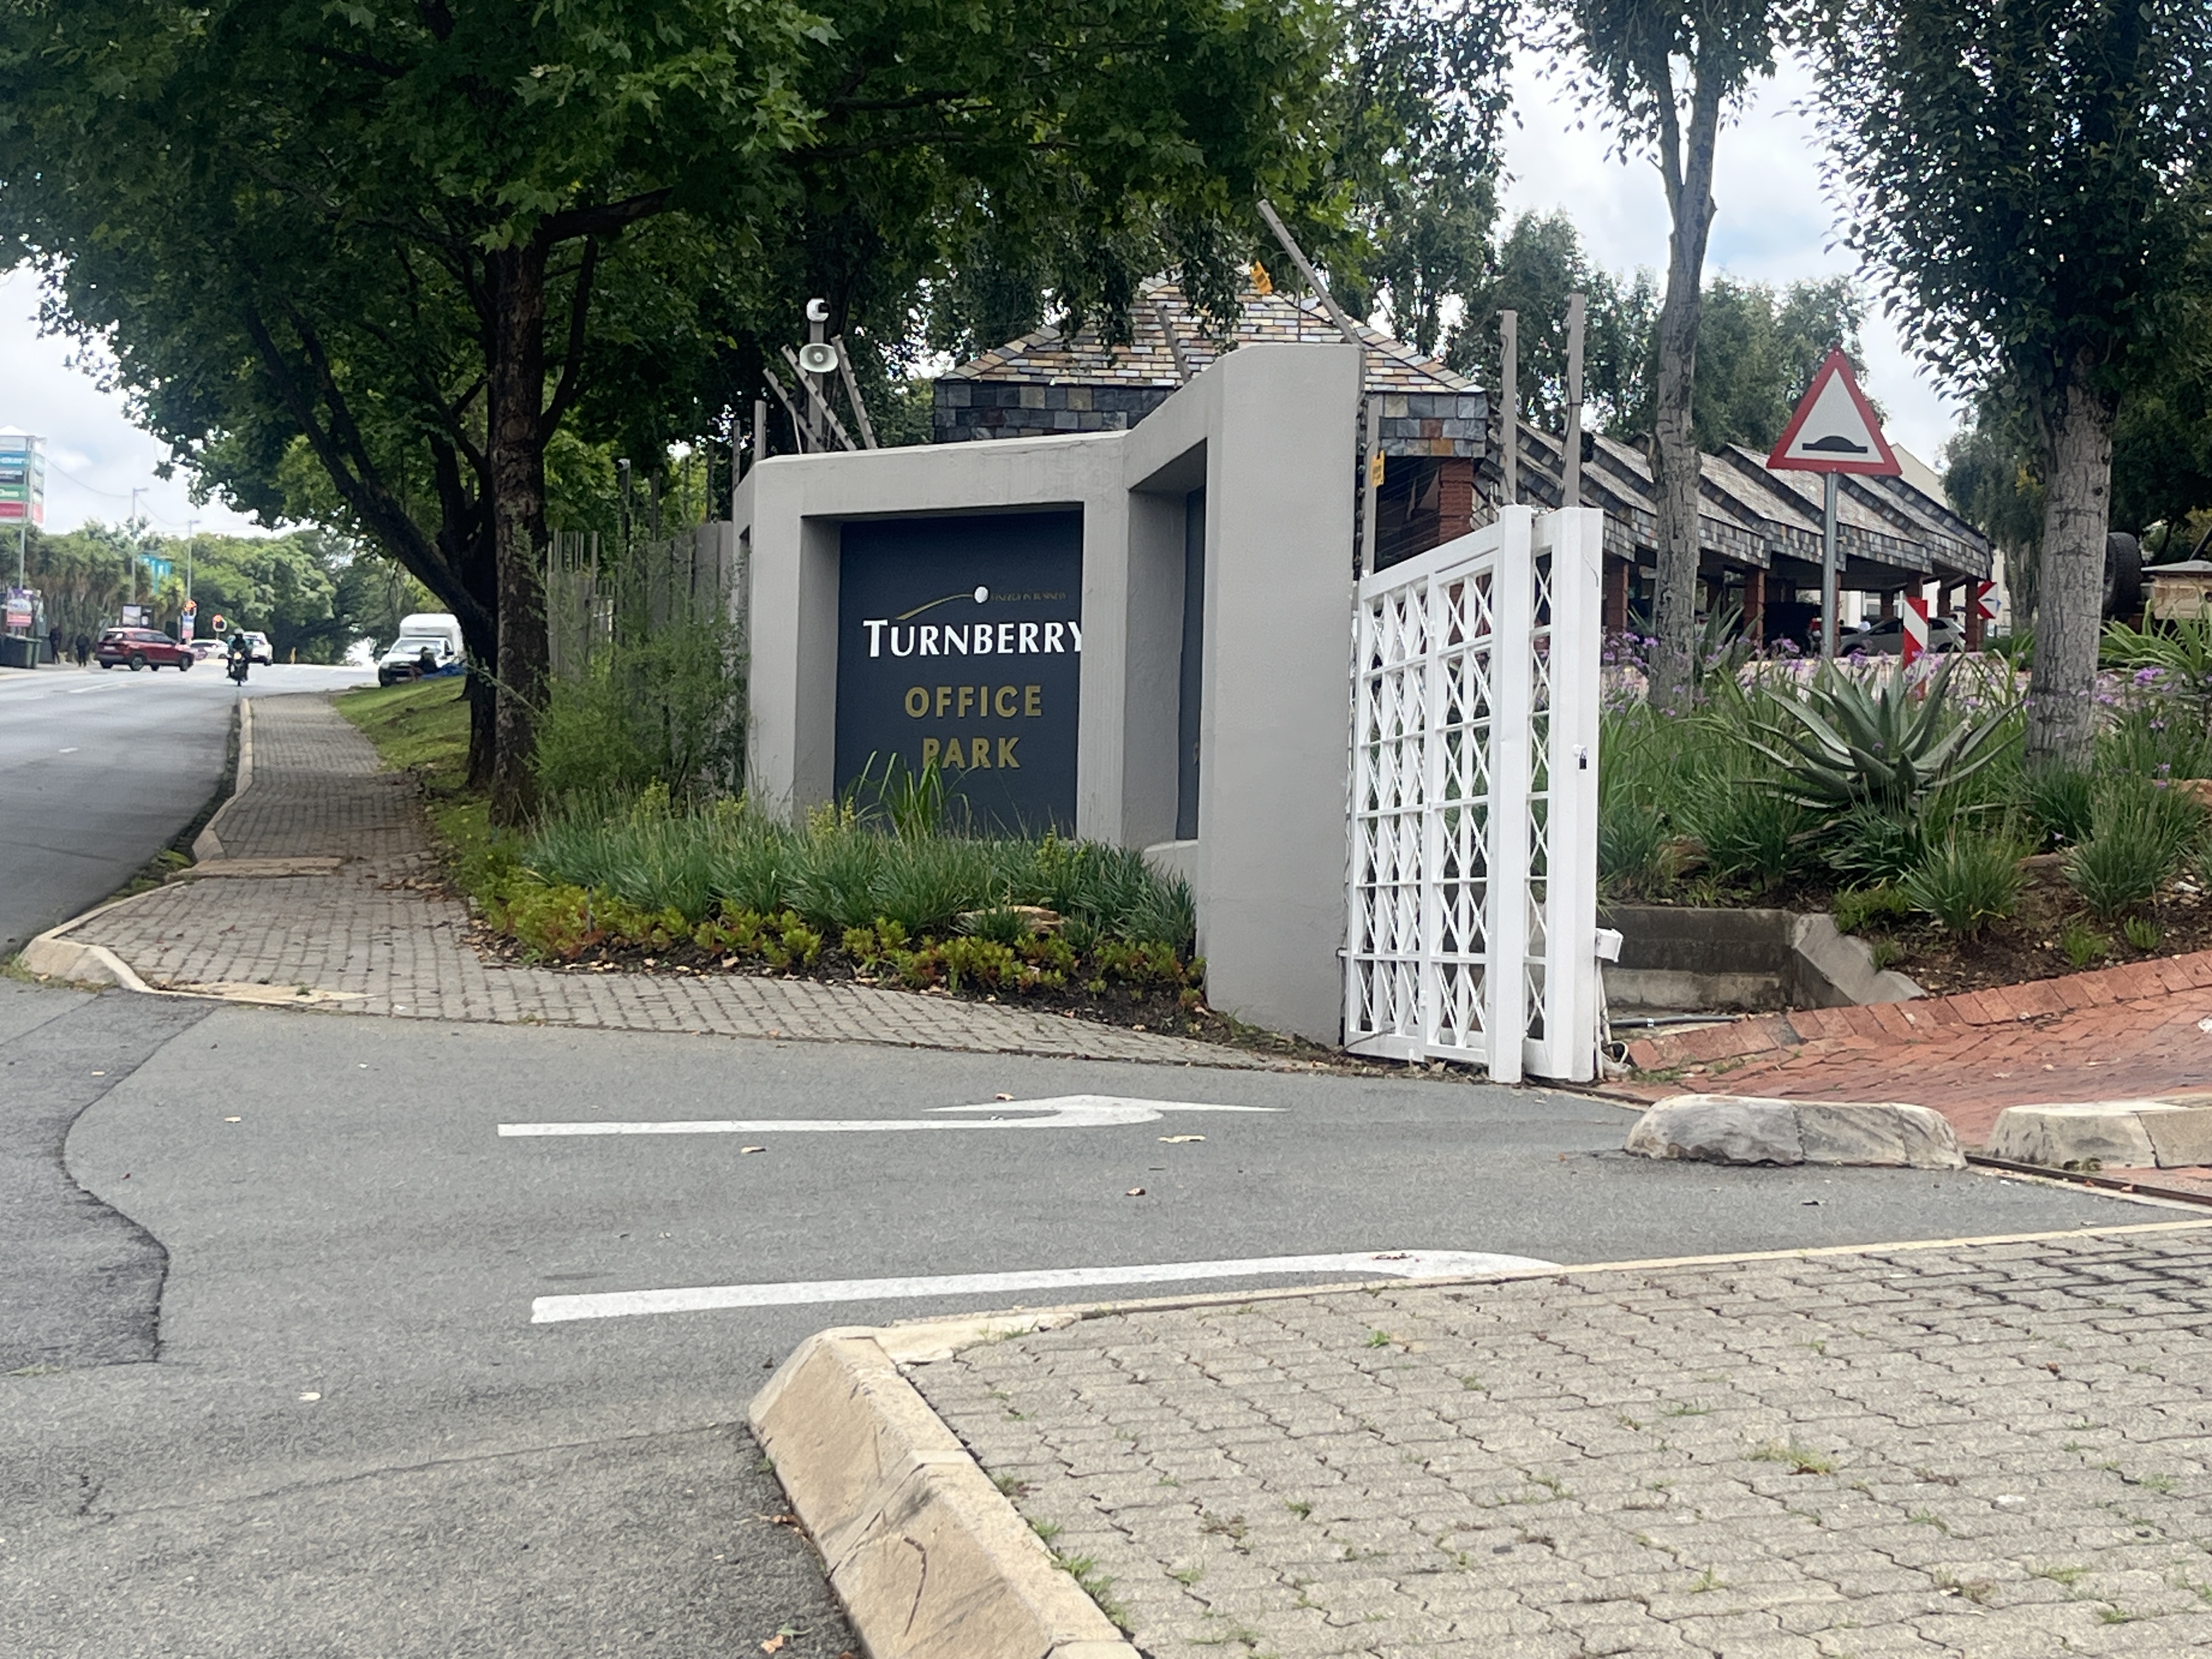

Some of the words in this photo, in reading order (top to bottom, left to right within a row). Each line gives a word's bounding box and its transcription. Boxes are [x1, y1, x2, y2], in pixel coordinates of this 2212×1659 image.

[863, 619, 1082, 657] TURNBERRY
[905, 685, 1042, 718] OFFICE
[922, 737, 1020, 769] PARK
